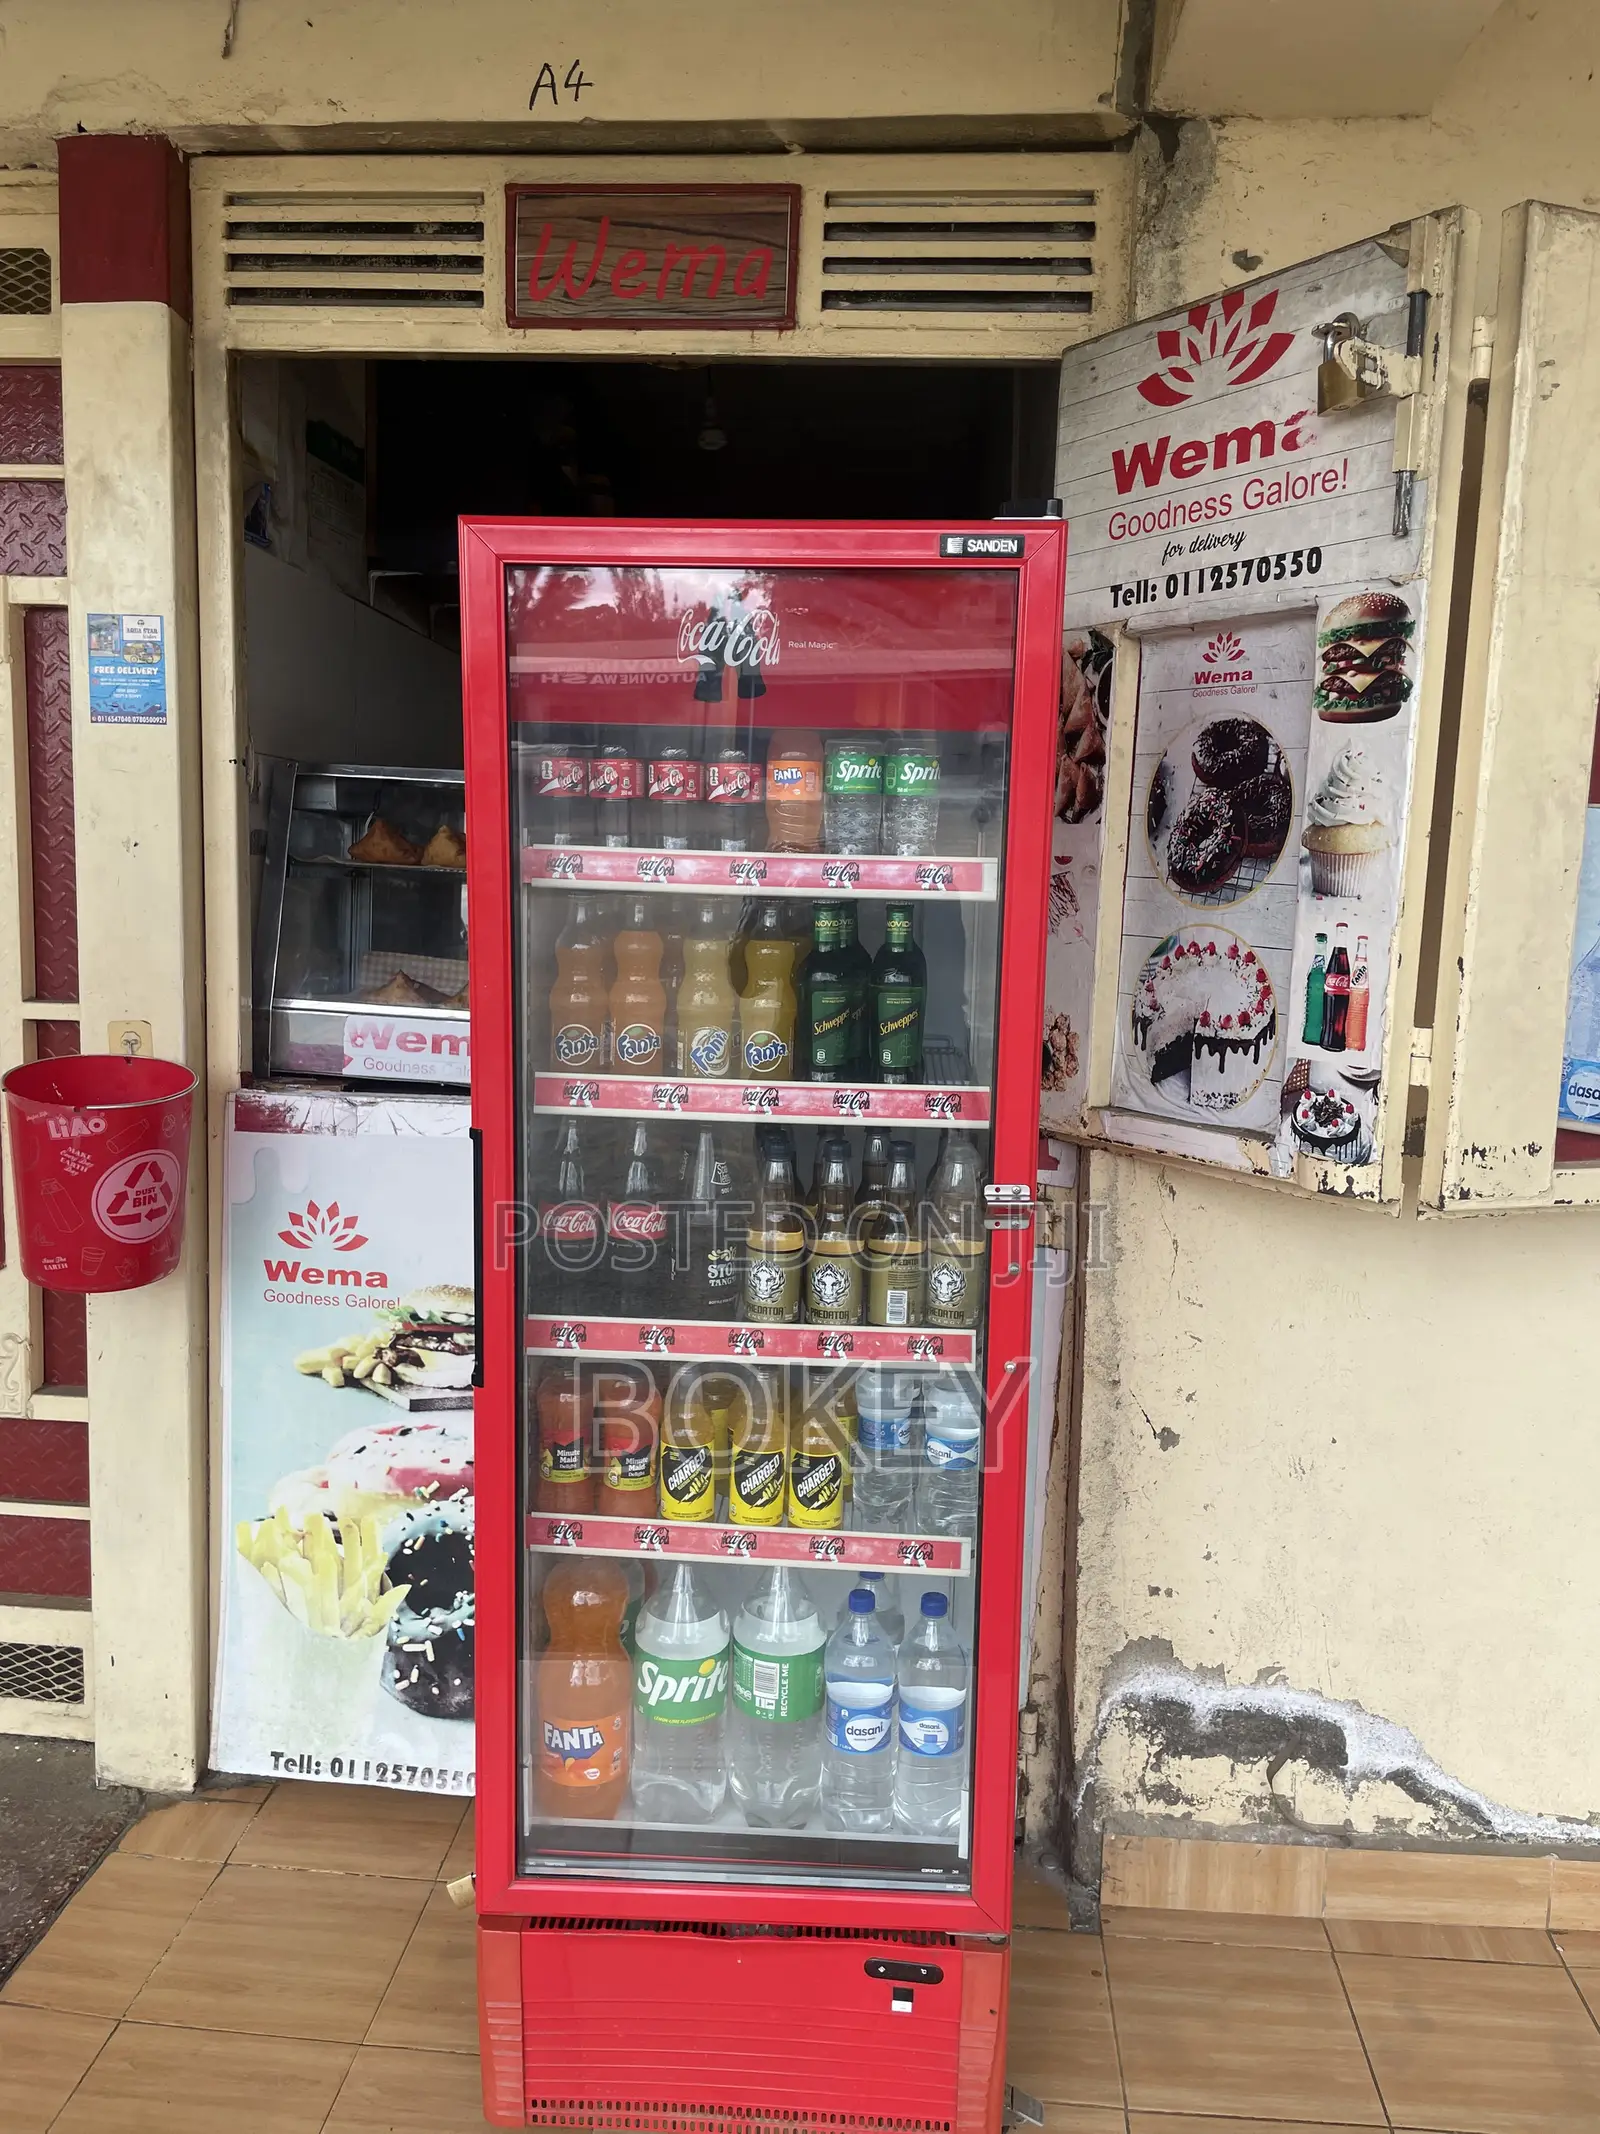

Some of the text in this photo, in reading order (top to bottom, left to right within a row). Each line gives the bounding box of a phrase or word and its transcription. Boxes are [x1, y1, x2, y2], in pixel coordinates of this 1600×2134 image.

[529, 59, 594, 111] A4
[527, 216, 775, 303] Wema
[1108, 458, 1350, 541] Goodness Galore!
[967, 539, 1018, 553] SANDEN
[1161, 530, 1248, 566] for delivery
[1109, 546, 1323, 608] Tell: 0112570550
[788, 640, 834, 651] Real Magic
[94, 665, 159, 675] FREE DELIVERY
[1194, 669, 1253, 685] Wema
[1192, 688, 1229, 698] Goodness
[773, 767, 803, 782] FANTA
[554, 1033, 599, 1060] Fanta
[616, 1031, 661, 1060] Fanta
[690, 1030, 729, 1073] Fanta
[744, 1038, 788, 1067] Fanta
[362, 1056, 437, 1075] Goodness
[132, 1193, 158, 1208] BIN
[135, 1186, 156, 1197] DUST
[542, 1210, 598, 1234] Coca-Cola
[613, 1210, 667, 1235] Coca-Cola
[43, 1262, 68, 1271] EARTH
[263, 1259, 389, 1289] Wema
[263, 1288, 401, 1312] Goodness Galore!
[810, 1306, 850, 1320] PREDATOR
[556, 1449, 581, 1458] Minute
[625, 1457, 649, 1466] Minute
[628, 1464, 646, 1472] Maid
[668, 1449, 706, 1491] CHARGED
[740, 1454, 780, 1496] CHARGED
[797, 1457, 836, 1498] CHARGED
[637, 1658, 728, 1706] Sprite
[780, 1662, 790, 1717] RECYCLE ME
[543, 1720, 604, 1750] FANTA
[846, 1720, 884, 1737] dasani
[919, 1722, 941, 1731] dasani
[270, 1750, 322, 1776] Tell:
